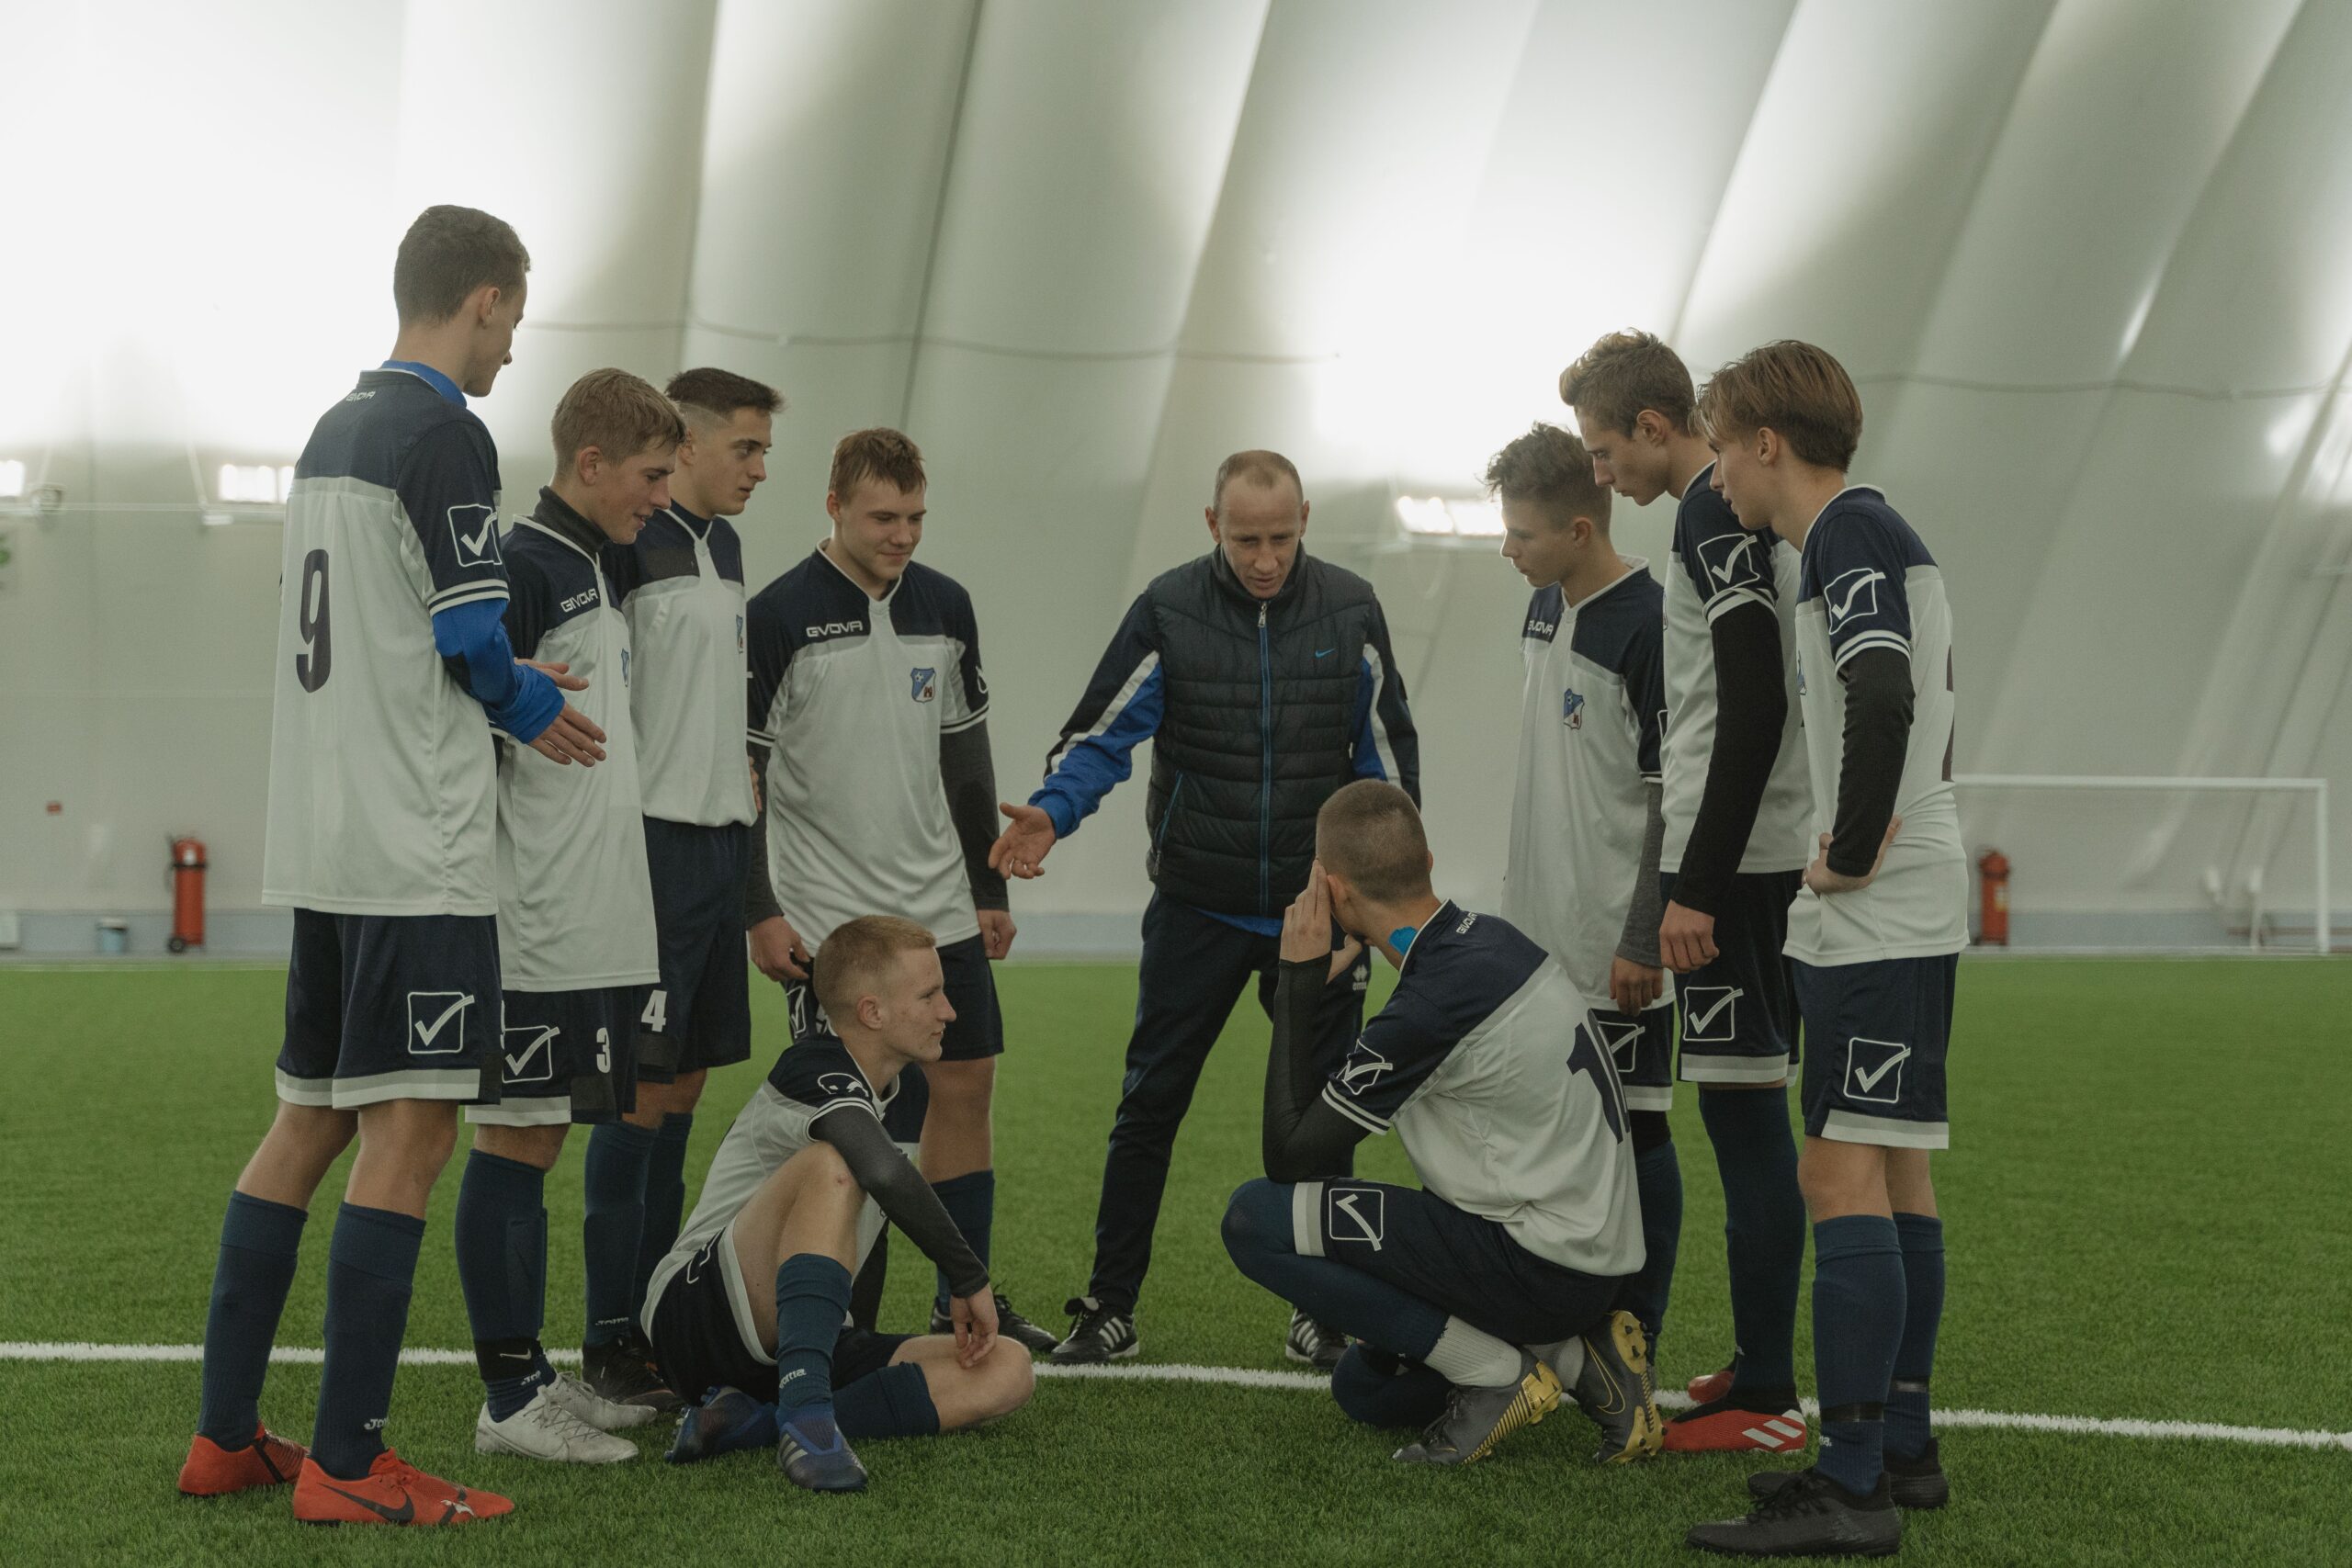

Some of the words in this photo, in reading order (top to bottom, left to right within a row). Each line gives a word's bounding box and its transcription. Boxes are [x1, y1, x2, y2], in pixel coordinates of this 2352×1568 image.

[296, 548, 332, 694] 9
[560, 587, 599, 613] GIVOVA
[640, 988, 668, 1032] 4
[595, 1027, 611, 1074] 3
